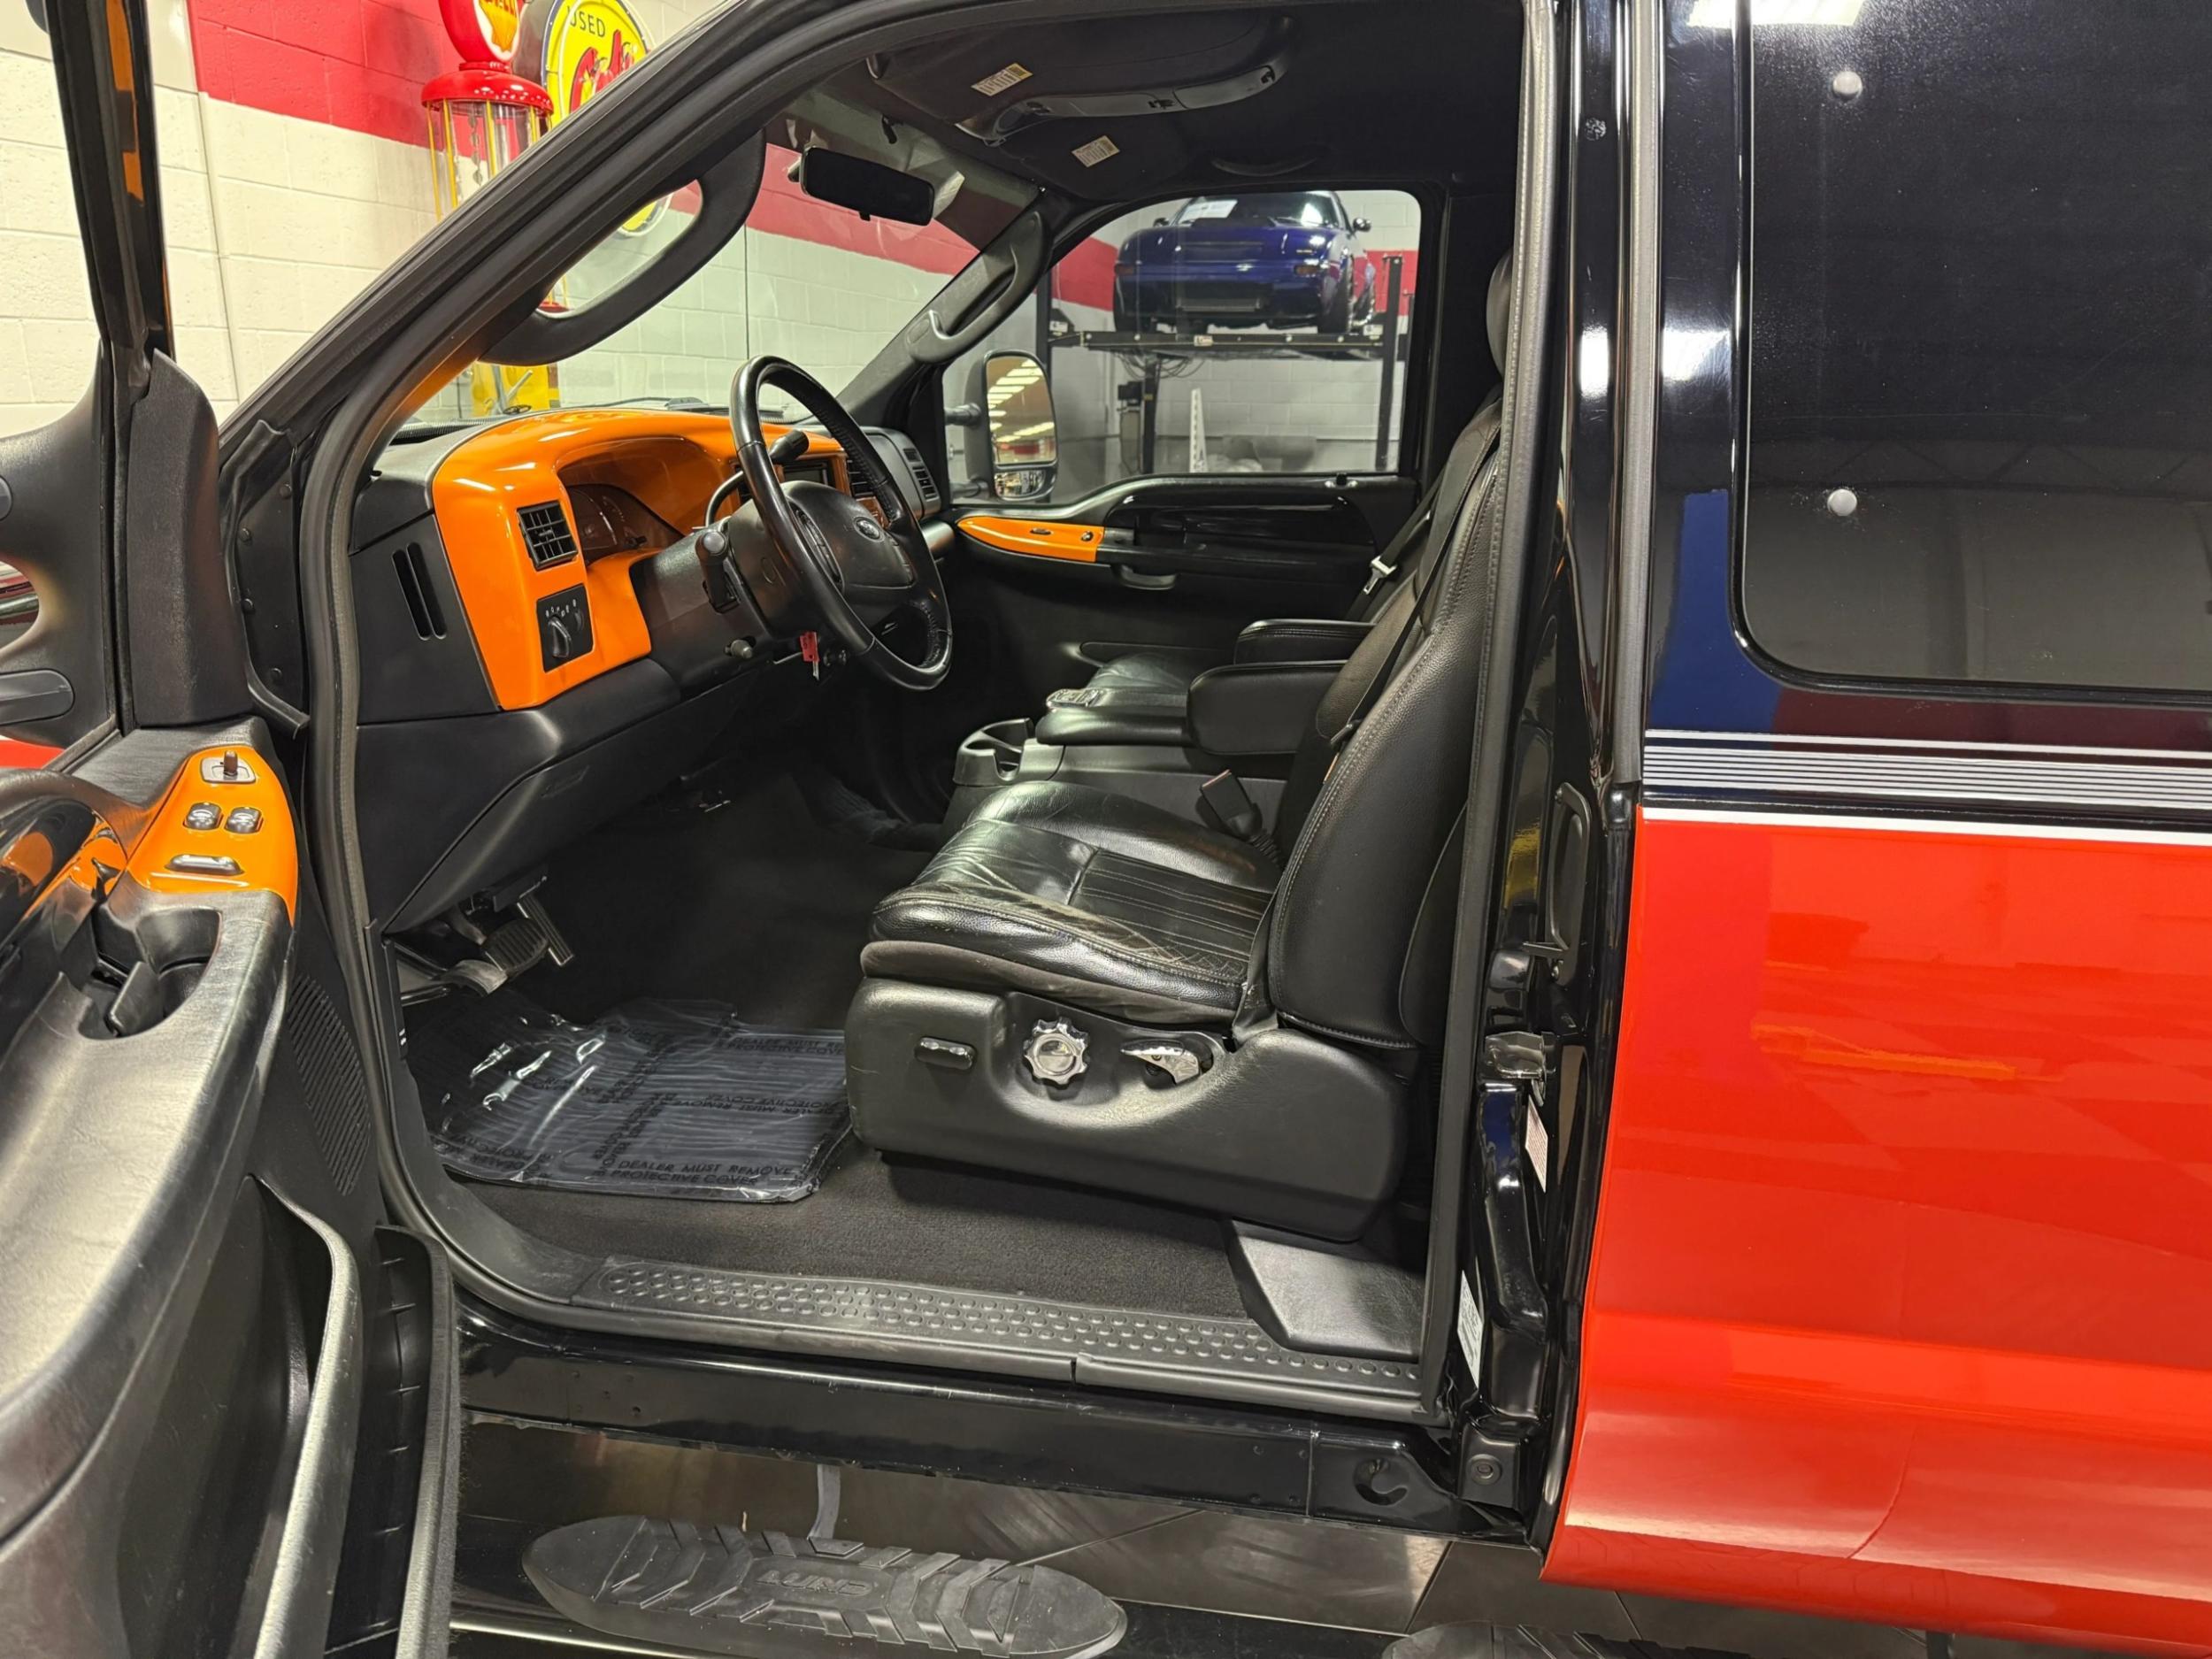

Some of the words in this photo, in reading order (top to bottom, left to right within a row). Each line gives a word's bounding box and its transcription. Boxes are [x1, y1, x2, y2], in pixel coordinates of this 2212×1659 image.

[618, 1160, 675, 1172] DEALER
[680, 1163, 722, 1173] MUST
[728, 1164, 794, 1176] REMOVE
[610, 1170, 701, 1183] PROTECTIVE
[703, 1174, 759, 1187] COVER
